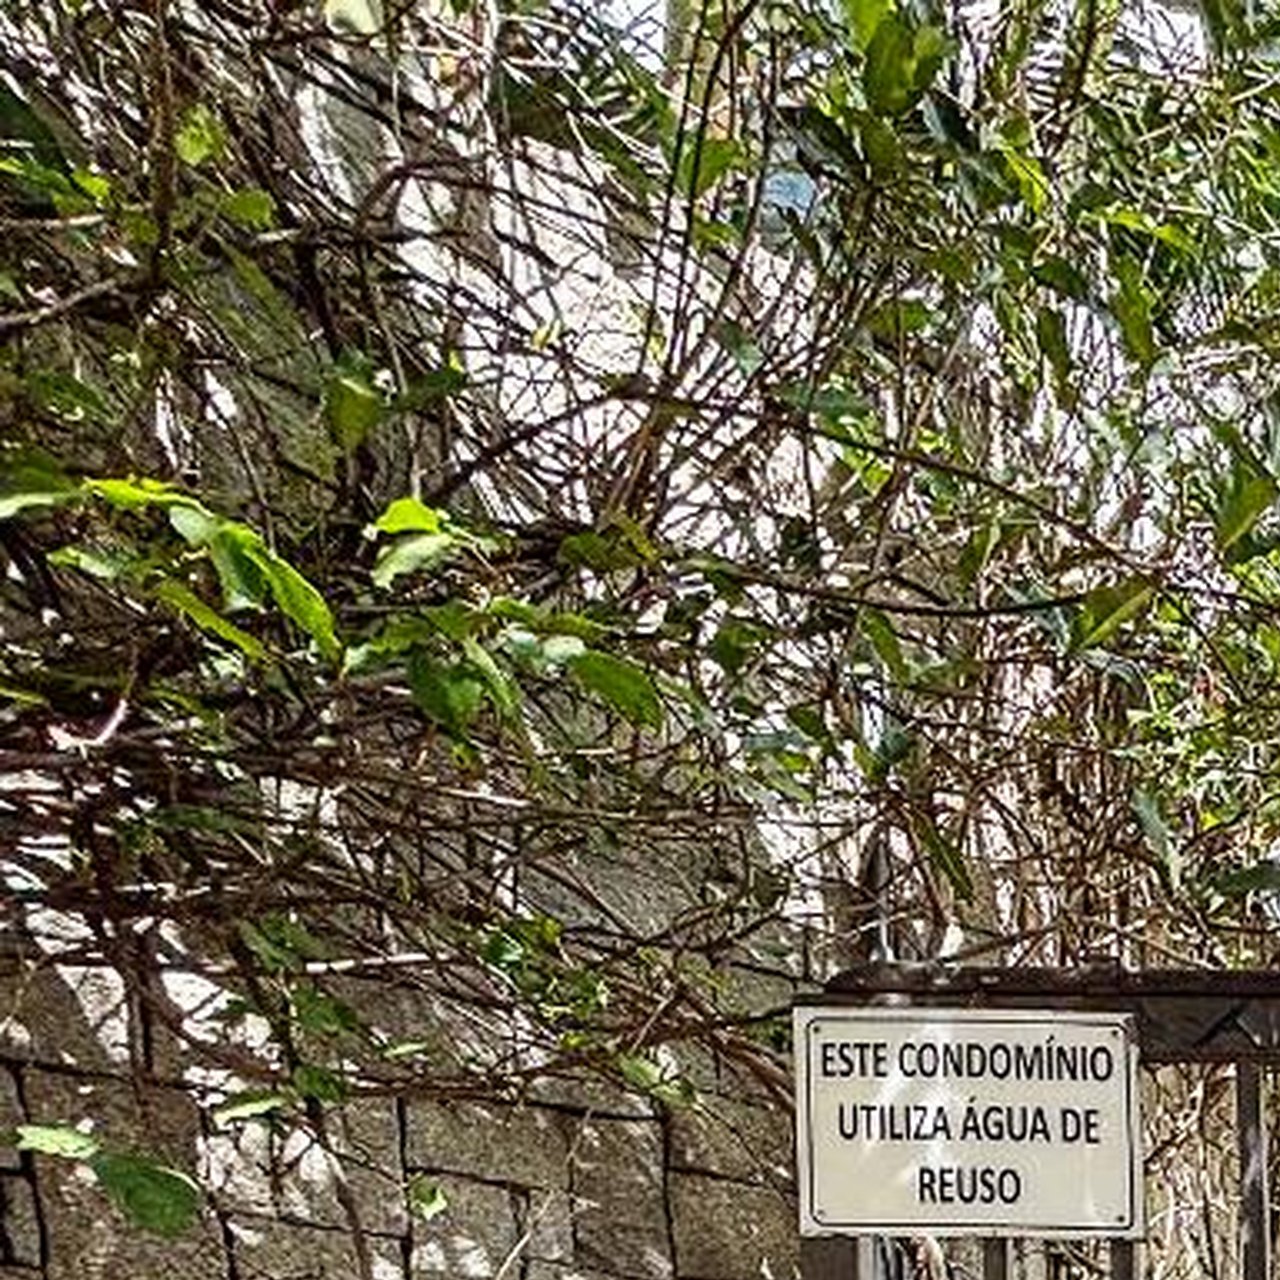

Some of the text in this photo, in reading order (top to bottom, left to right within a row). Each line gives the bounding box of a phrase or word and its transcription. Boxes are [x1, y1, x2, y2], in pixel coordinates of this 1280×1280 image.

[821, 1034, 1113, 1082] ESTE CONDOMÍNIO
[838, 1095, 1101, 1144] UTILIZA ÁGUA DE
[918, 1167, 1021, 1205] REUSO
